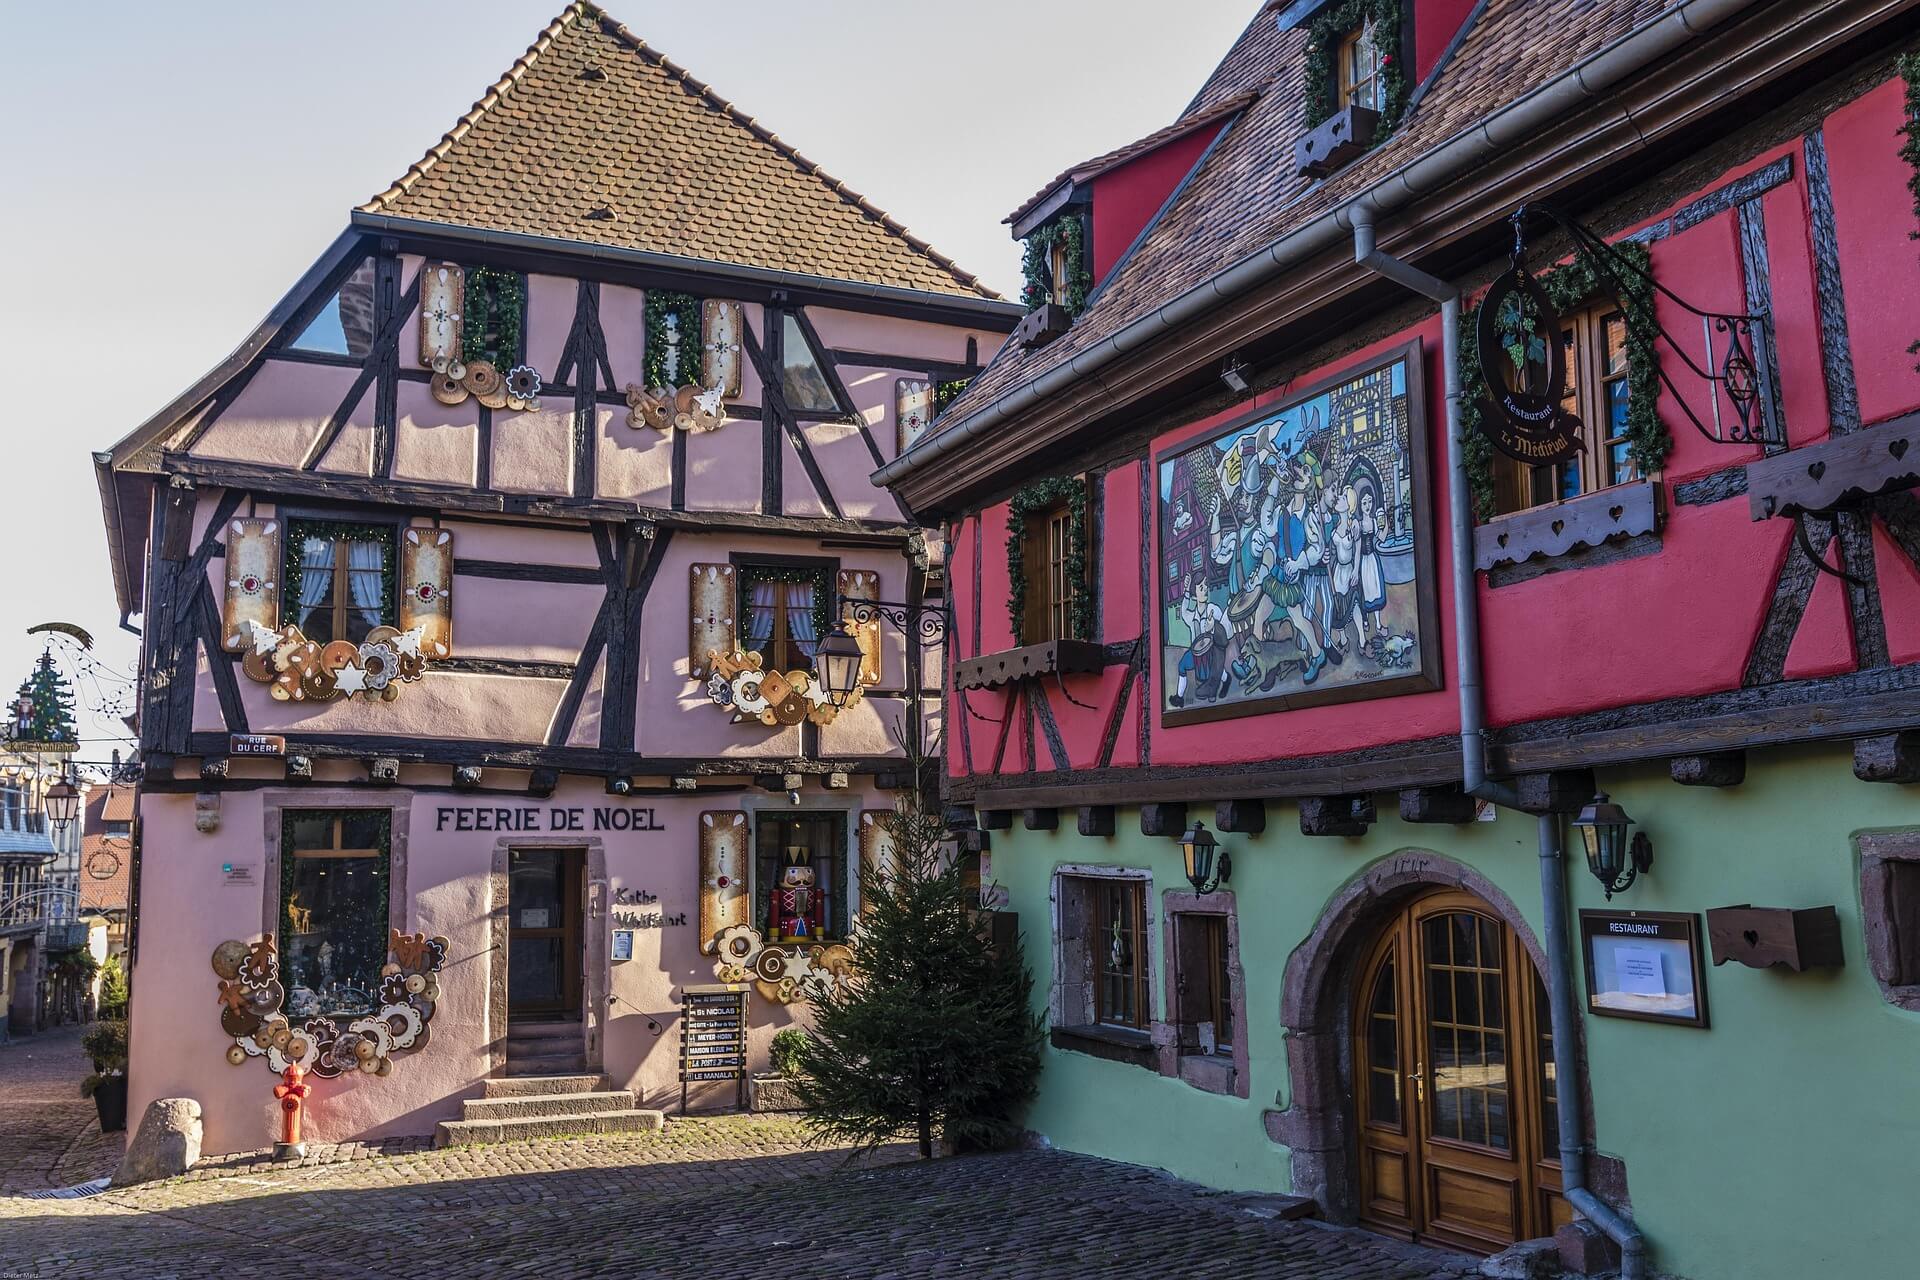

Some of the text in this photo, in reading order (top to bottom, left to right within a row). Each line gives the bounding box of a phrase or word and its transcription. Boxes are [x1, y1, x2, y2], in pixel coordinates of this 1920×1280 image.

[1503, 395, 1553, 421] Restaurant
[237, 744, 278, 752] DU CERF
[436, 807, 665, 831] FEERIE DE NOEL
[1609, 922, 1659, 935] RESTAURANT
[706, 1007, 735, 1015] NICOLAS
[703, 1071, 733, 1079] MANALA
